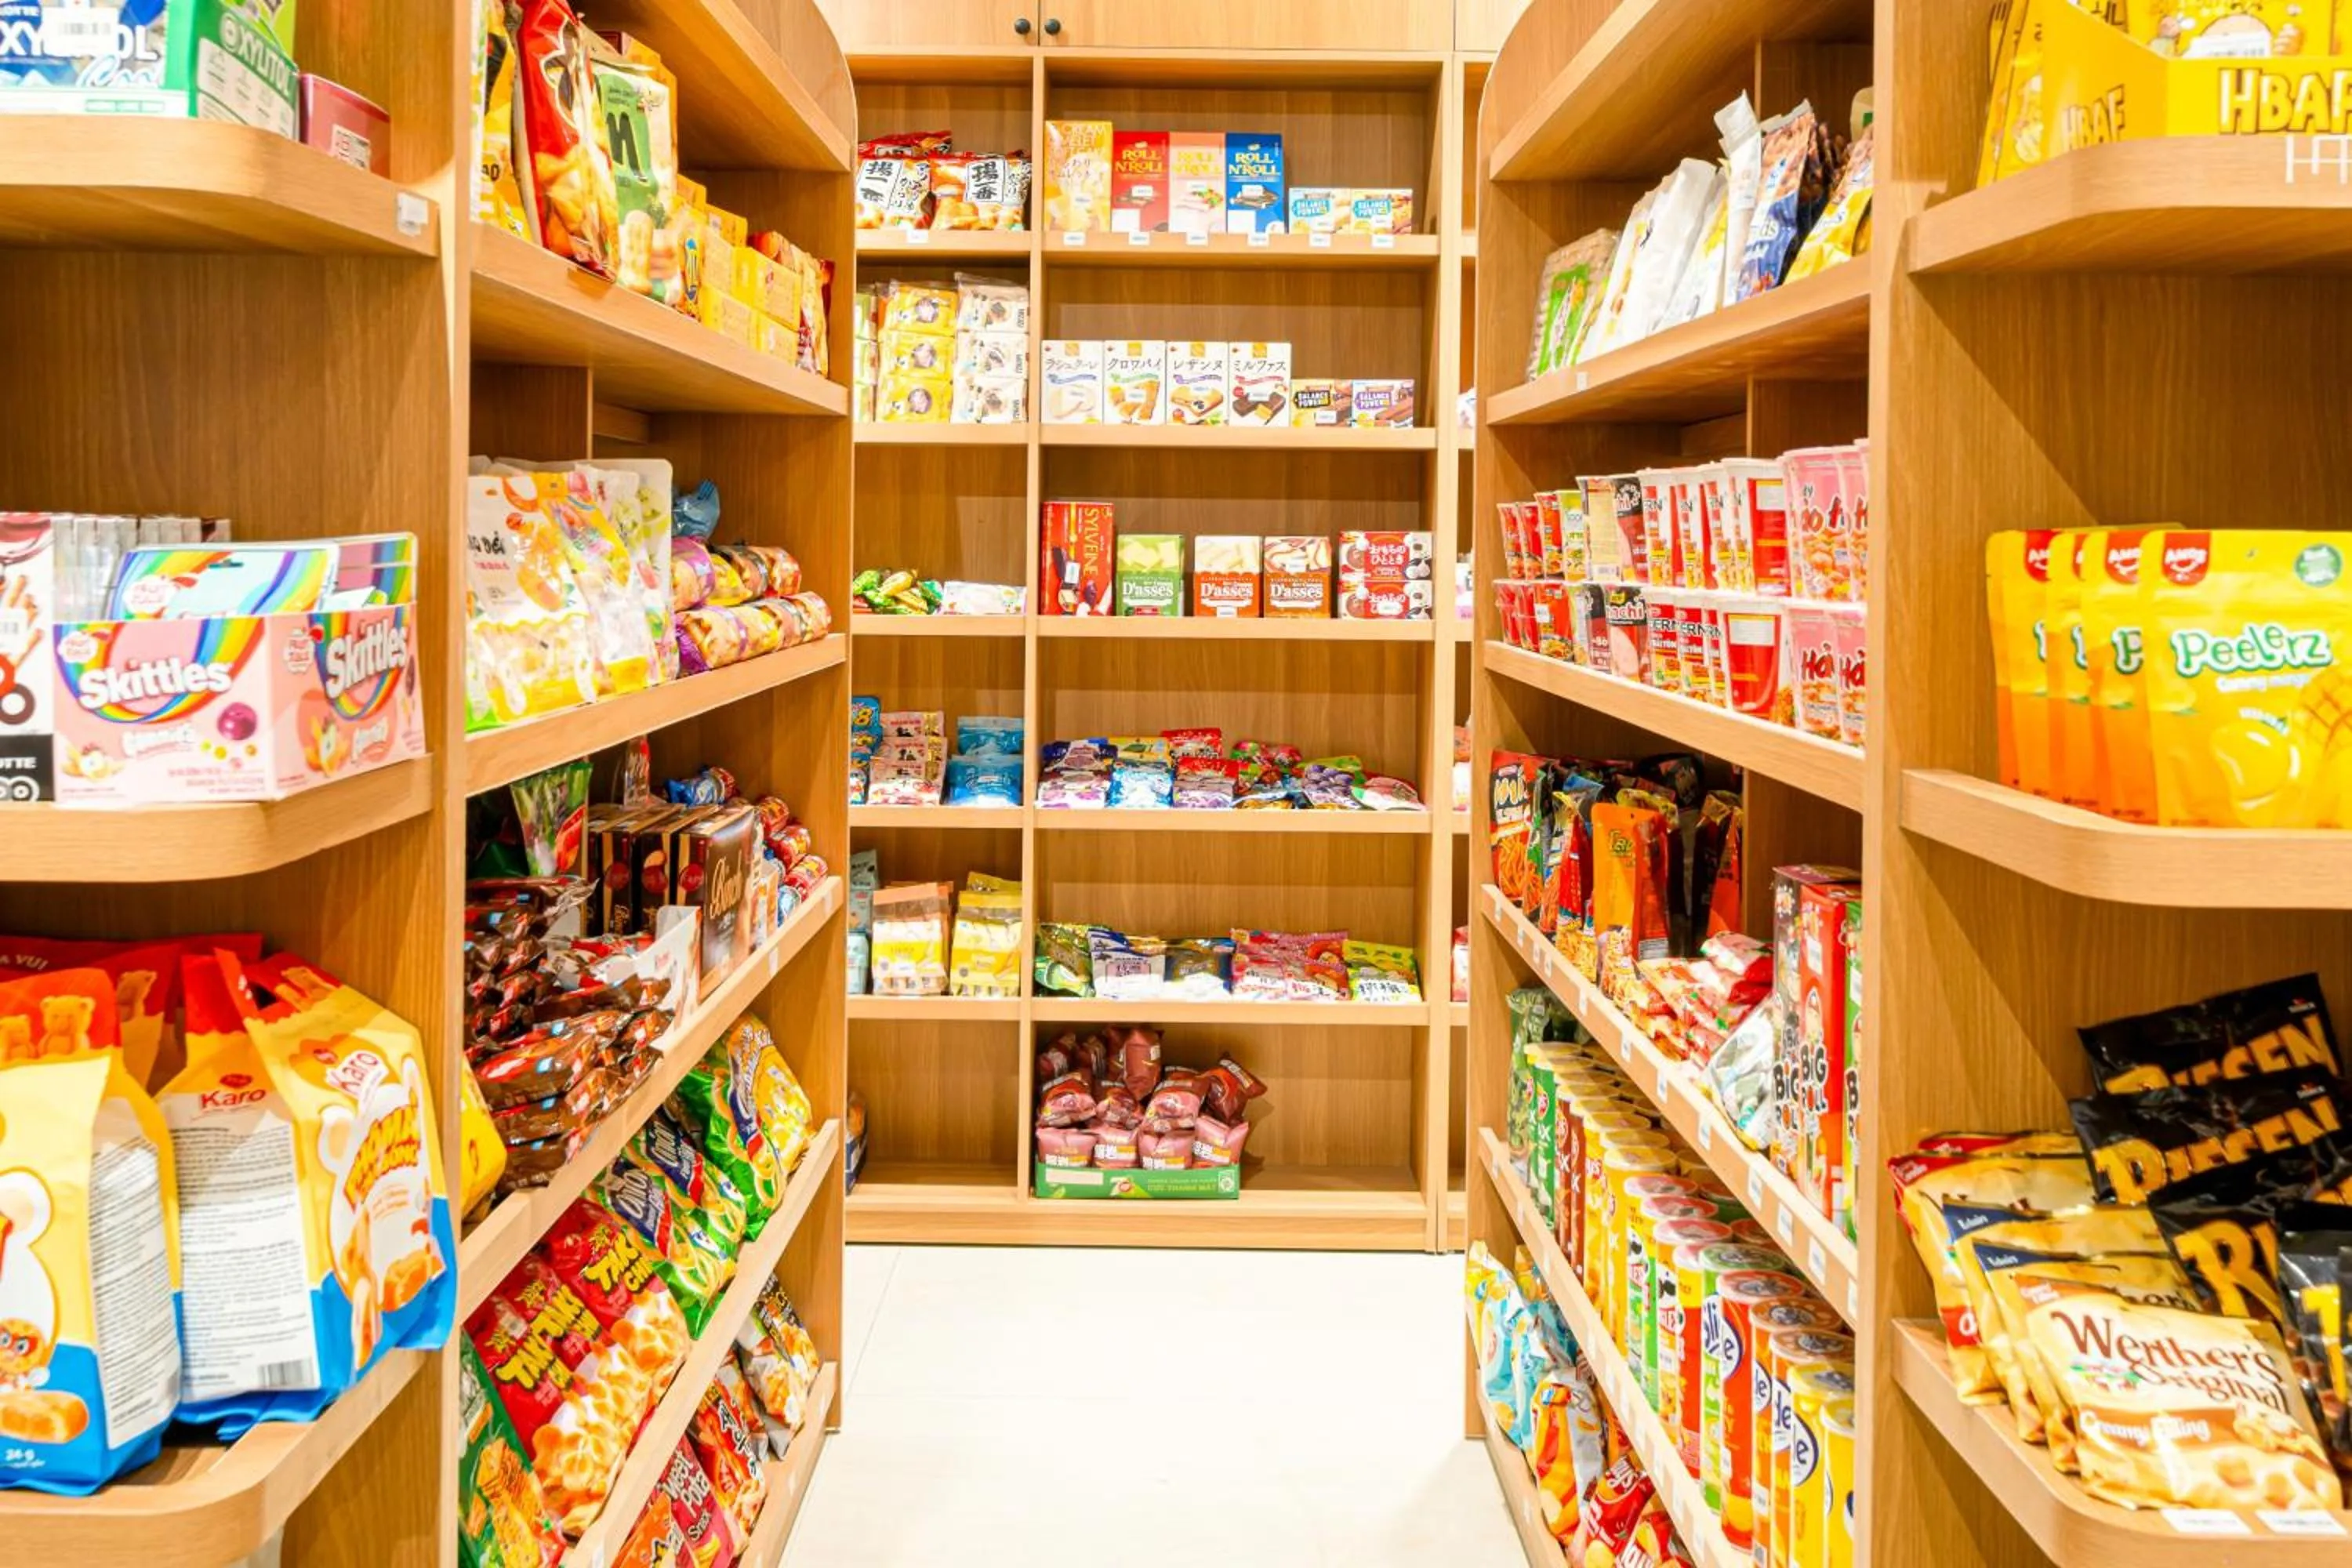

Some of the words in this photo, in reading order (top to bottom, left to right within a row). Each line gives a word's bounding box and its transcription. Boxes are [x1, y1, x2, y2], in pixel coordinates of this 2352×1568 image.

[1122, 149, 1161, 162] ROLL
[1234, 152, 1274, 164] ROLL
[1200, 583, 1254, 597] D'asses
[1270, 583, 1323, 597] D'asses
[325, 615, 408, 700] Skittles
[2173, 623, 2331, 674] Peelerz
[78, 655, 234, 710] Skittles
[328, 1050, 381, 1094] Karo
[199, 1086, 267, 1111] Karo
[2049, 1309, 2284, 1384] Werther's
[2129, 1360, 2289, 1416] Original
